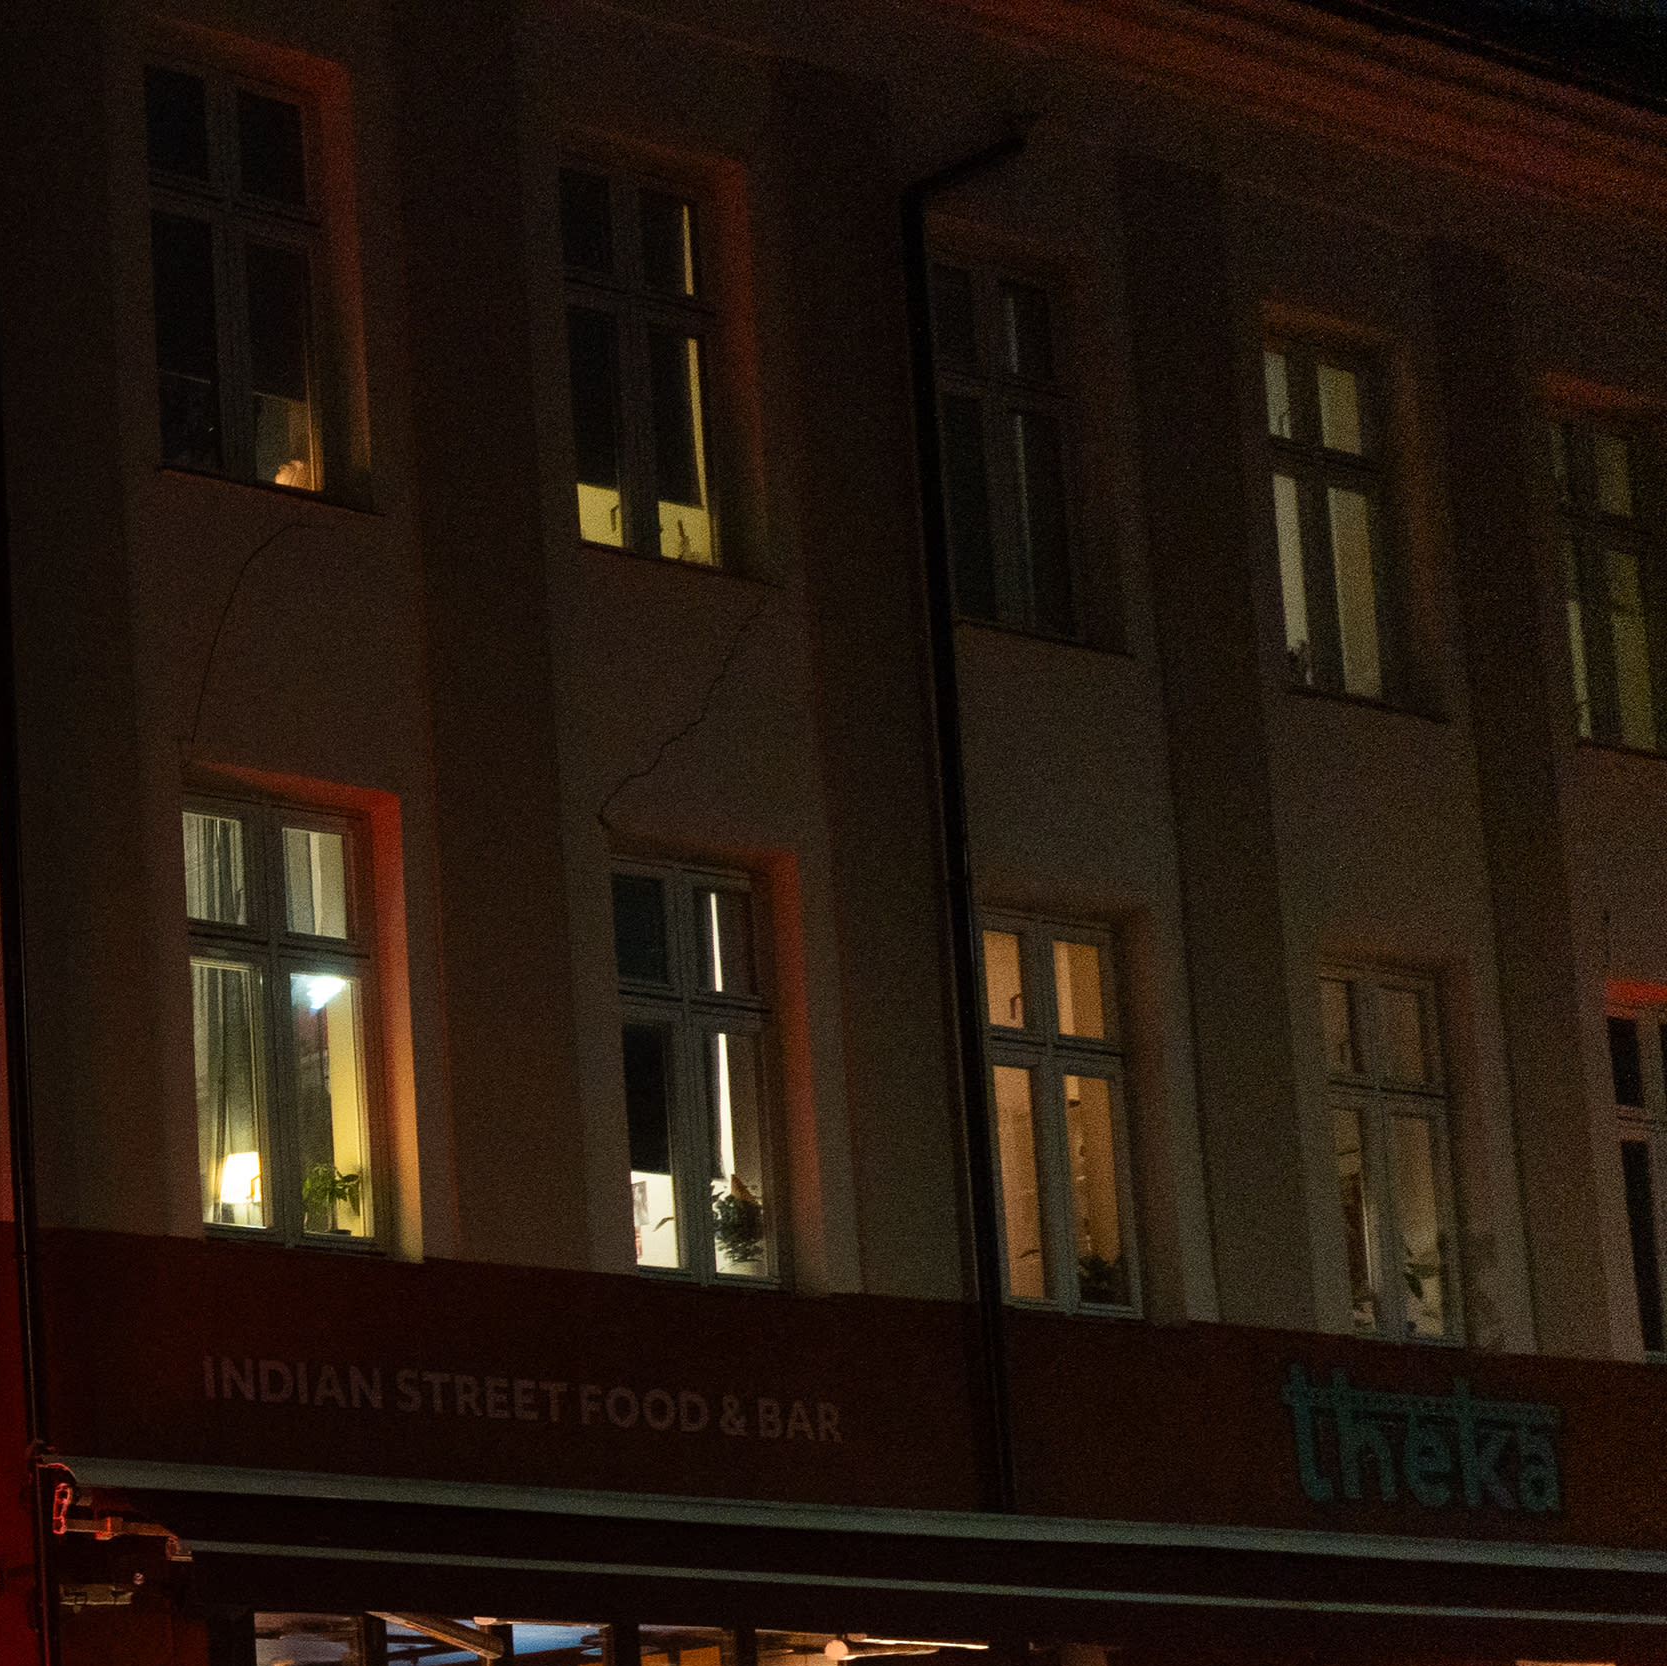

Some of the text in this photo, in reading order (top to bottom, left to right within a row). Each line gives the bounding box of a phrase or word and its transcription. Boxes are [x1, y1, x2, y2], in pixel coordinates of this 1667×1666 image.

[203, 1355, 843, 1443] INDIAN STREET FOOD & BAR
[1283, 1363, 1560, 1513] theka
